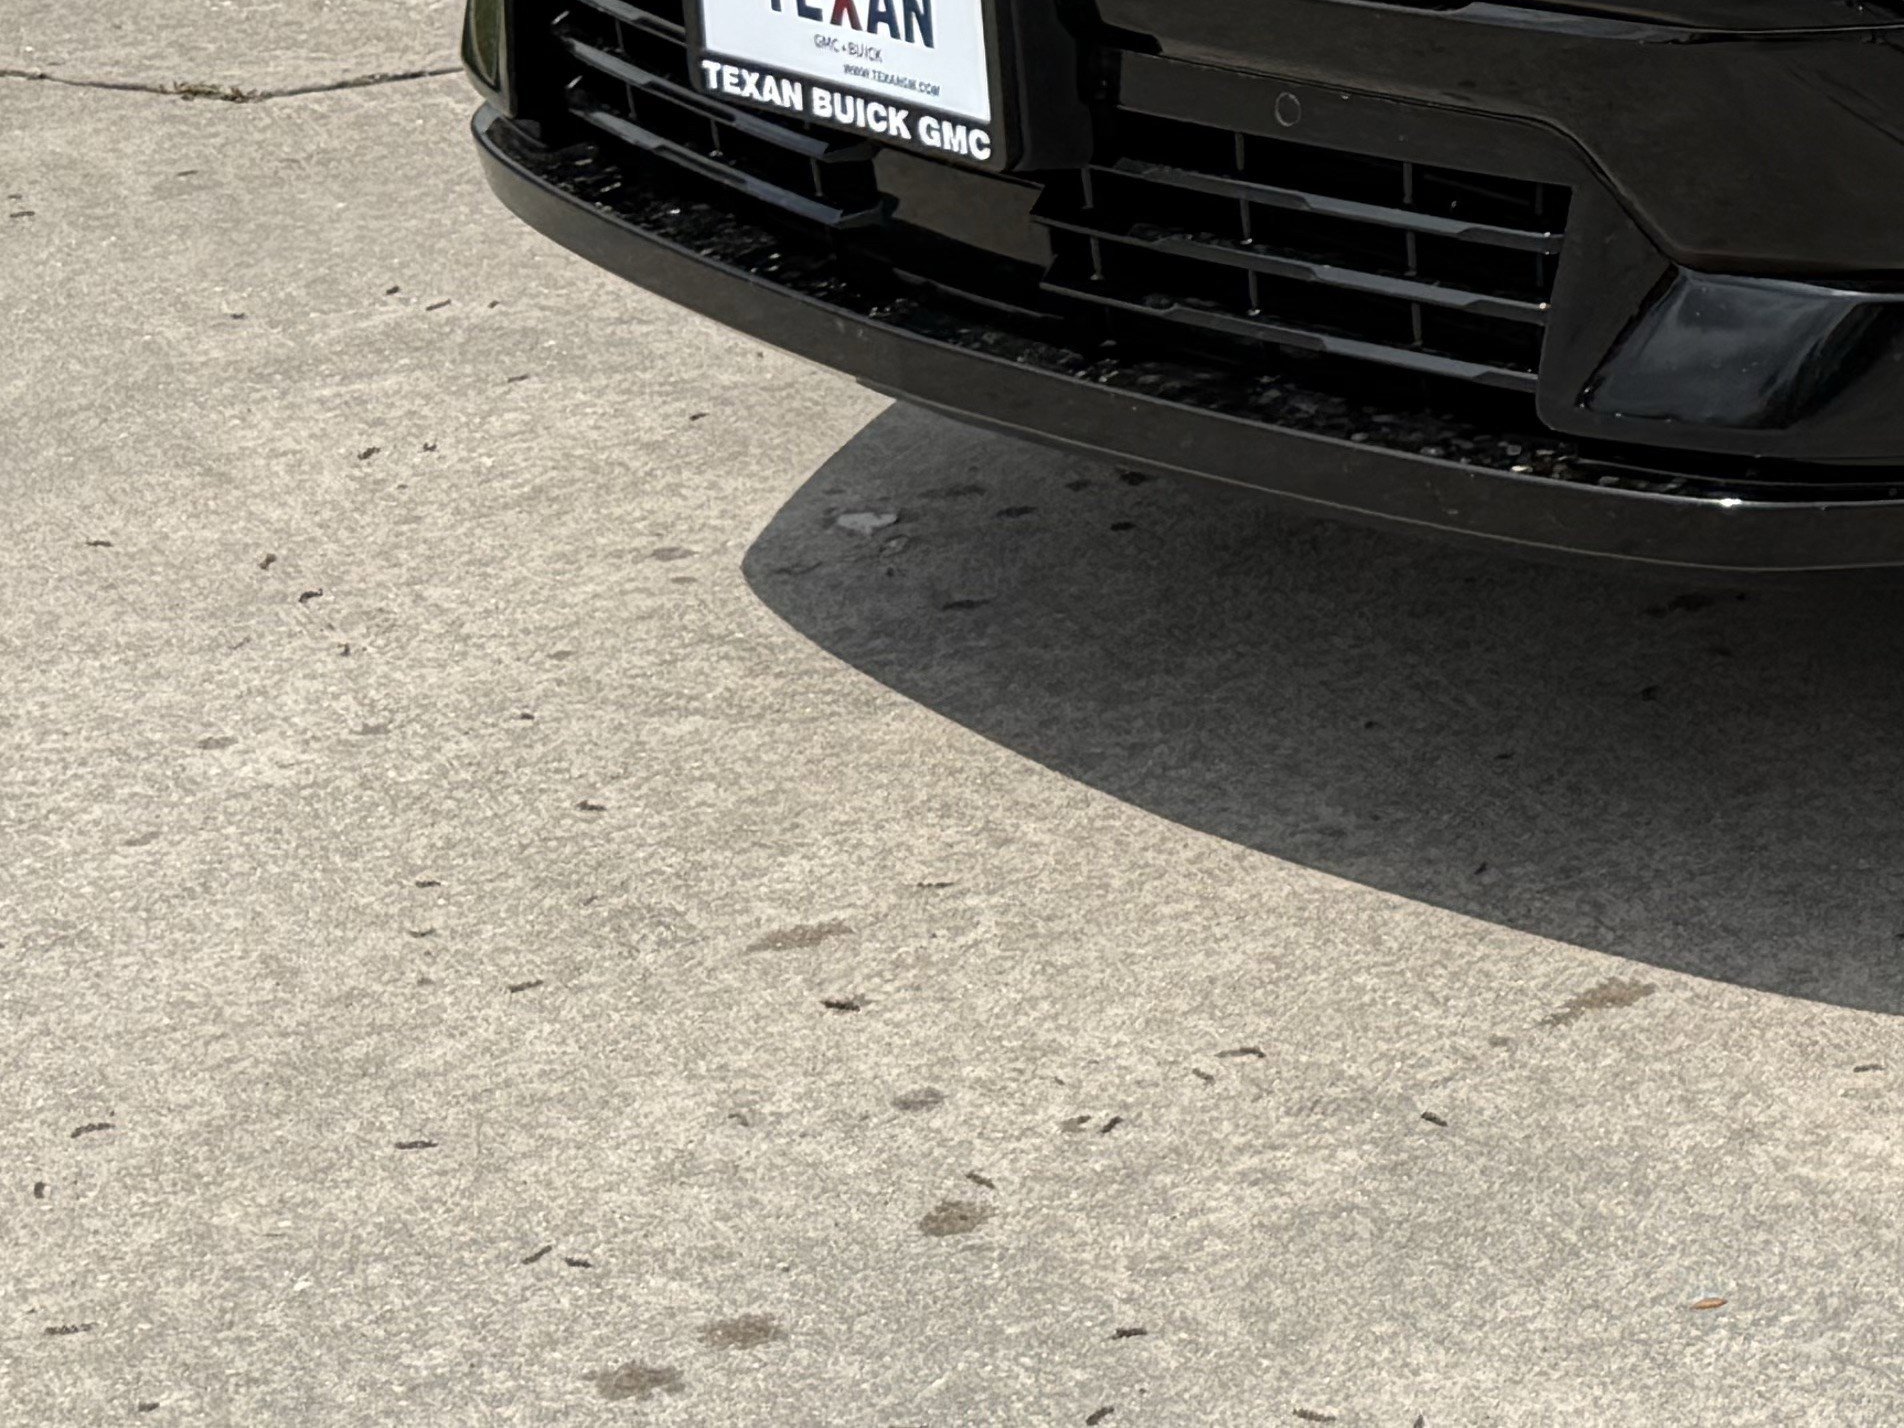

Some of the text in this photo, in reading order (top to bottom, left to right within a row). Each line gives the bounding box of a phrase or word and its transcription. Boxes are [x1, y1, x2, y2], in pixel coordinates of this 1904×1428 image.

[813, 33, 883, 63] GMC BUICK
[701, 59, 991, 161] TEXAN BUICK GMC
